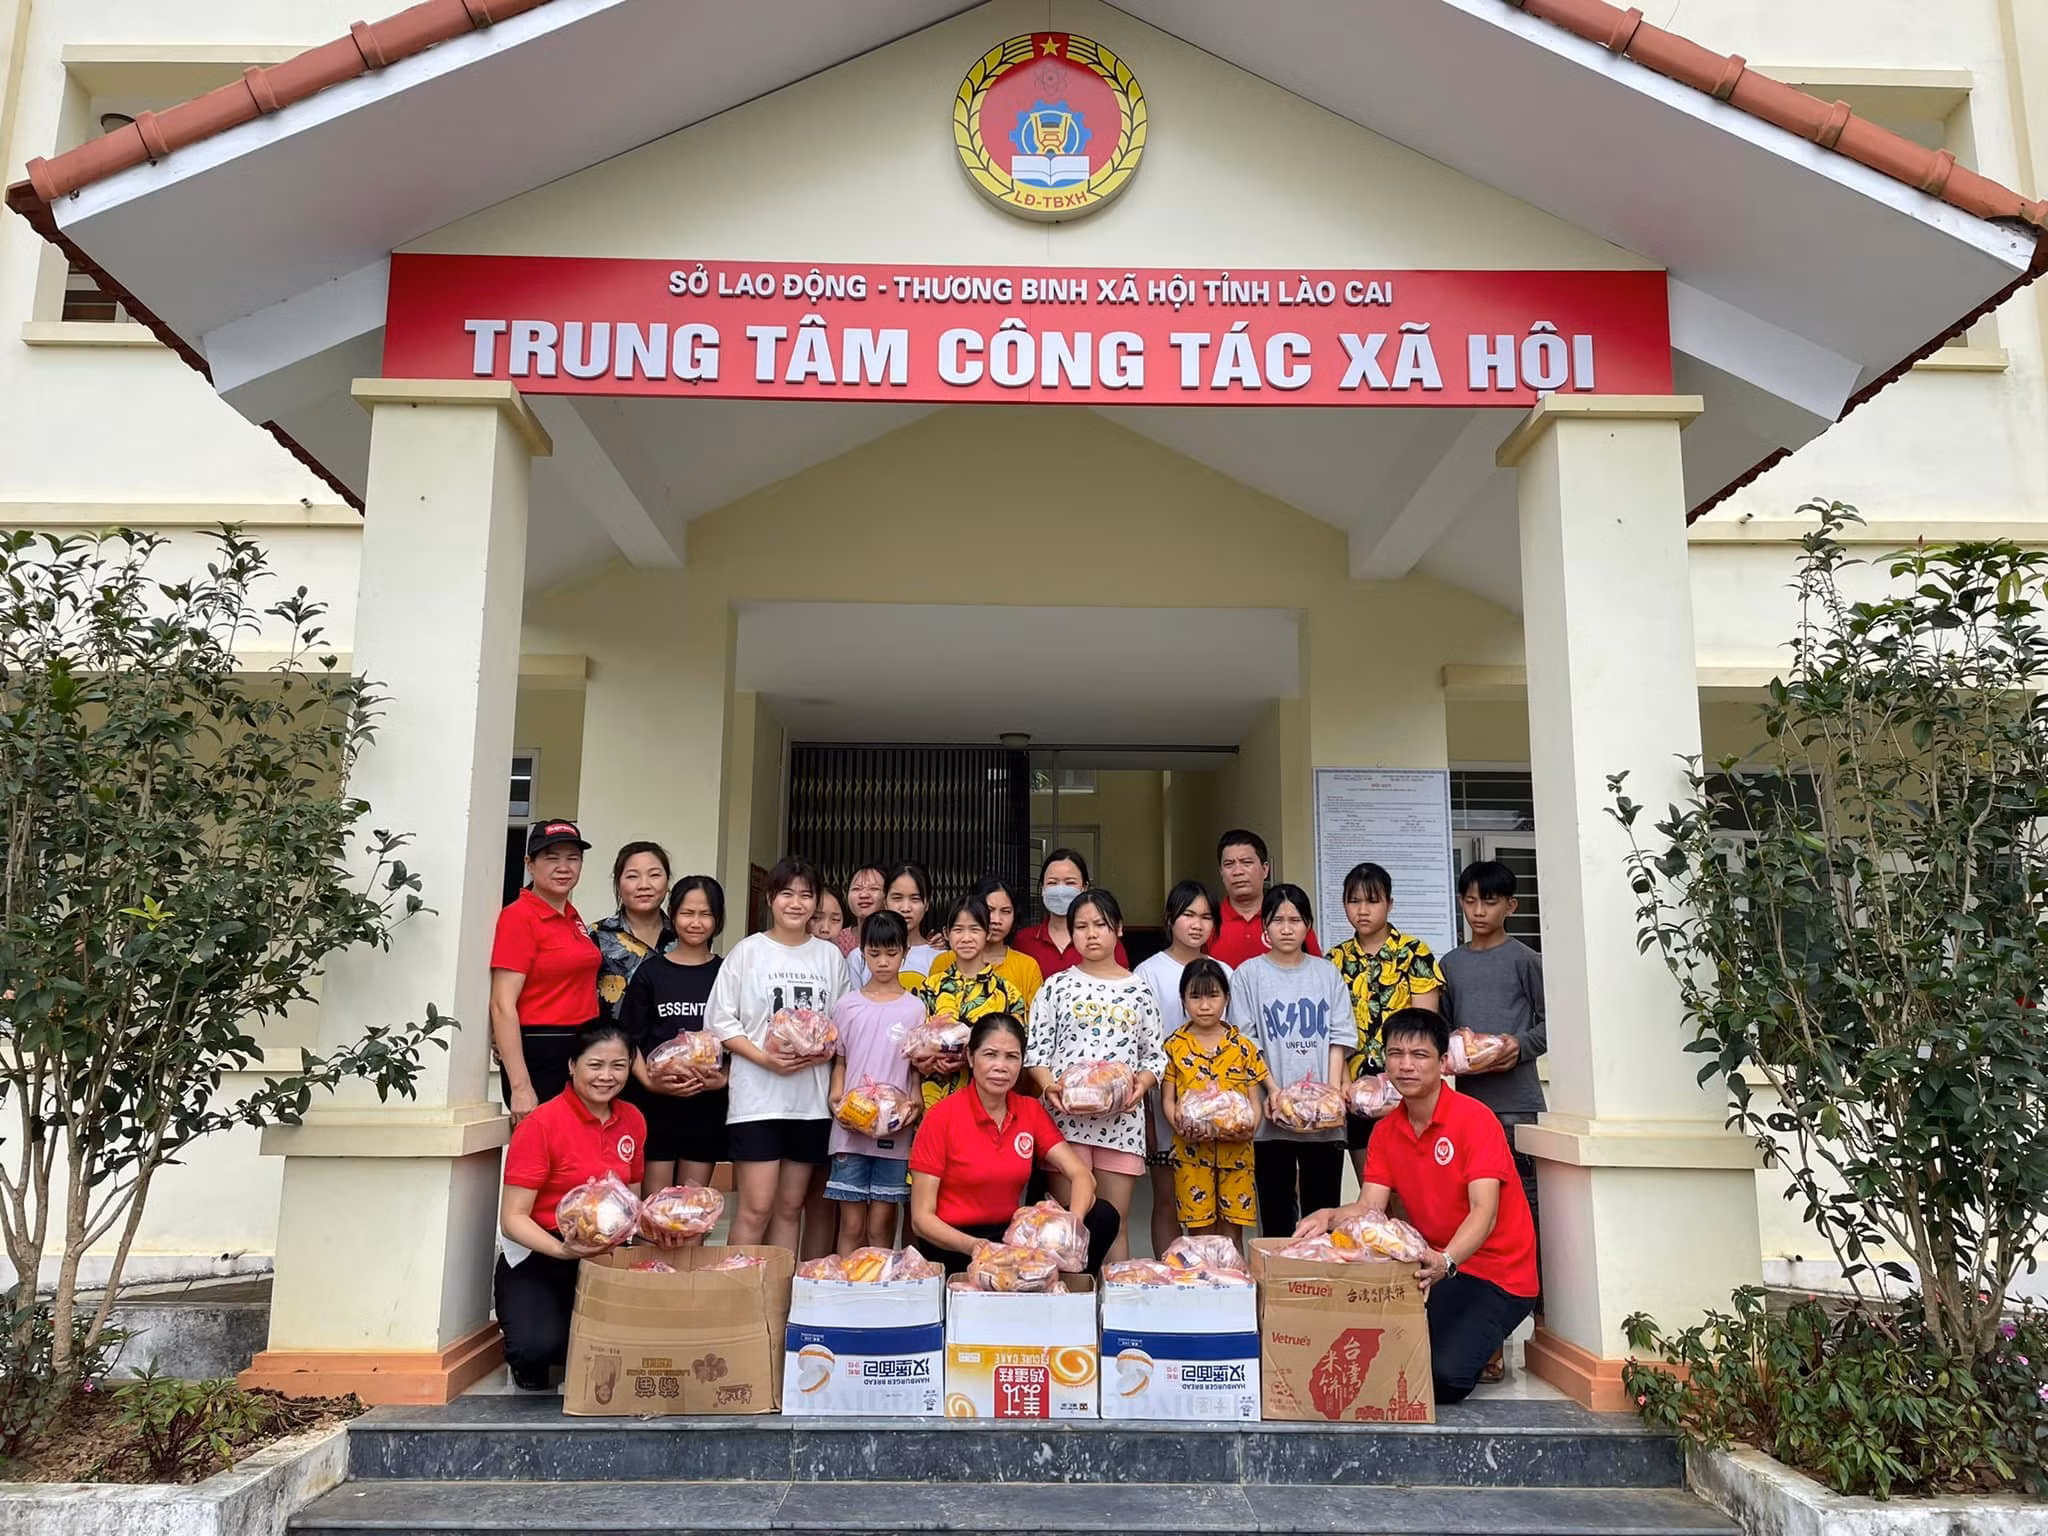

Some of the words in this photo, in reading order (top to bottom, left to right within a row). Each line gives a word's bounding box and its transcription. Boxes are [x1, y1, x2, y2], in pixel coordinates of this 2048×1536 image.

[1014, 190, 1089, 209] LĐ-TBXH
[668, 263, 709, 297] SỞ
[718, 272, 776, 299] LAO
[783, 268, 867, 305] ĐỘNG
[893, 274, 1013, 304] THƯƠNG
[1021, 277, 1088, 305] BINH
[1096, 273, 1140, 305] XÃ
[1147, 273, 1196, 311] HỘI
[1203, 271, 1270, 305] TỈNH
[1278, 275, 1337, 306] LÀO
[1344, 280, 1393, 307] CAI
[464, 319, 720, 383] TRUNG
[745, 313, 909, 386] TÂM
[937, 317, 1145, 389] CÔNG
[1169, 321, 1312, 391] TÁC
[1338, 321, 1444, 391] XÃ
[863, 1357, 930, 1378] 汉堡面包
[1181, 1364, 1246, 1383] 汉堡面包
[863, 1378, 886, 1386] BREAD
[887, 1377, 930, 1385] HAMBURGER
[1205, 1383, 1246, 1391] HAMBURGER
